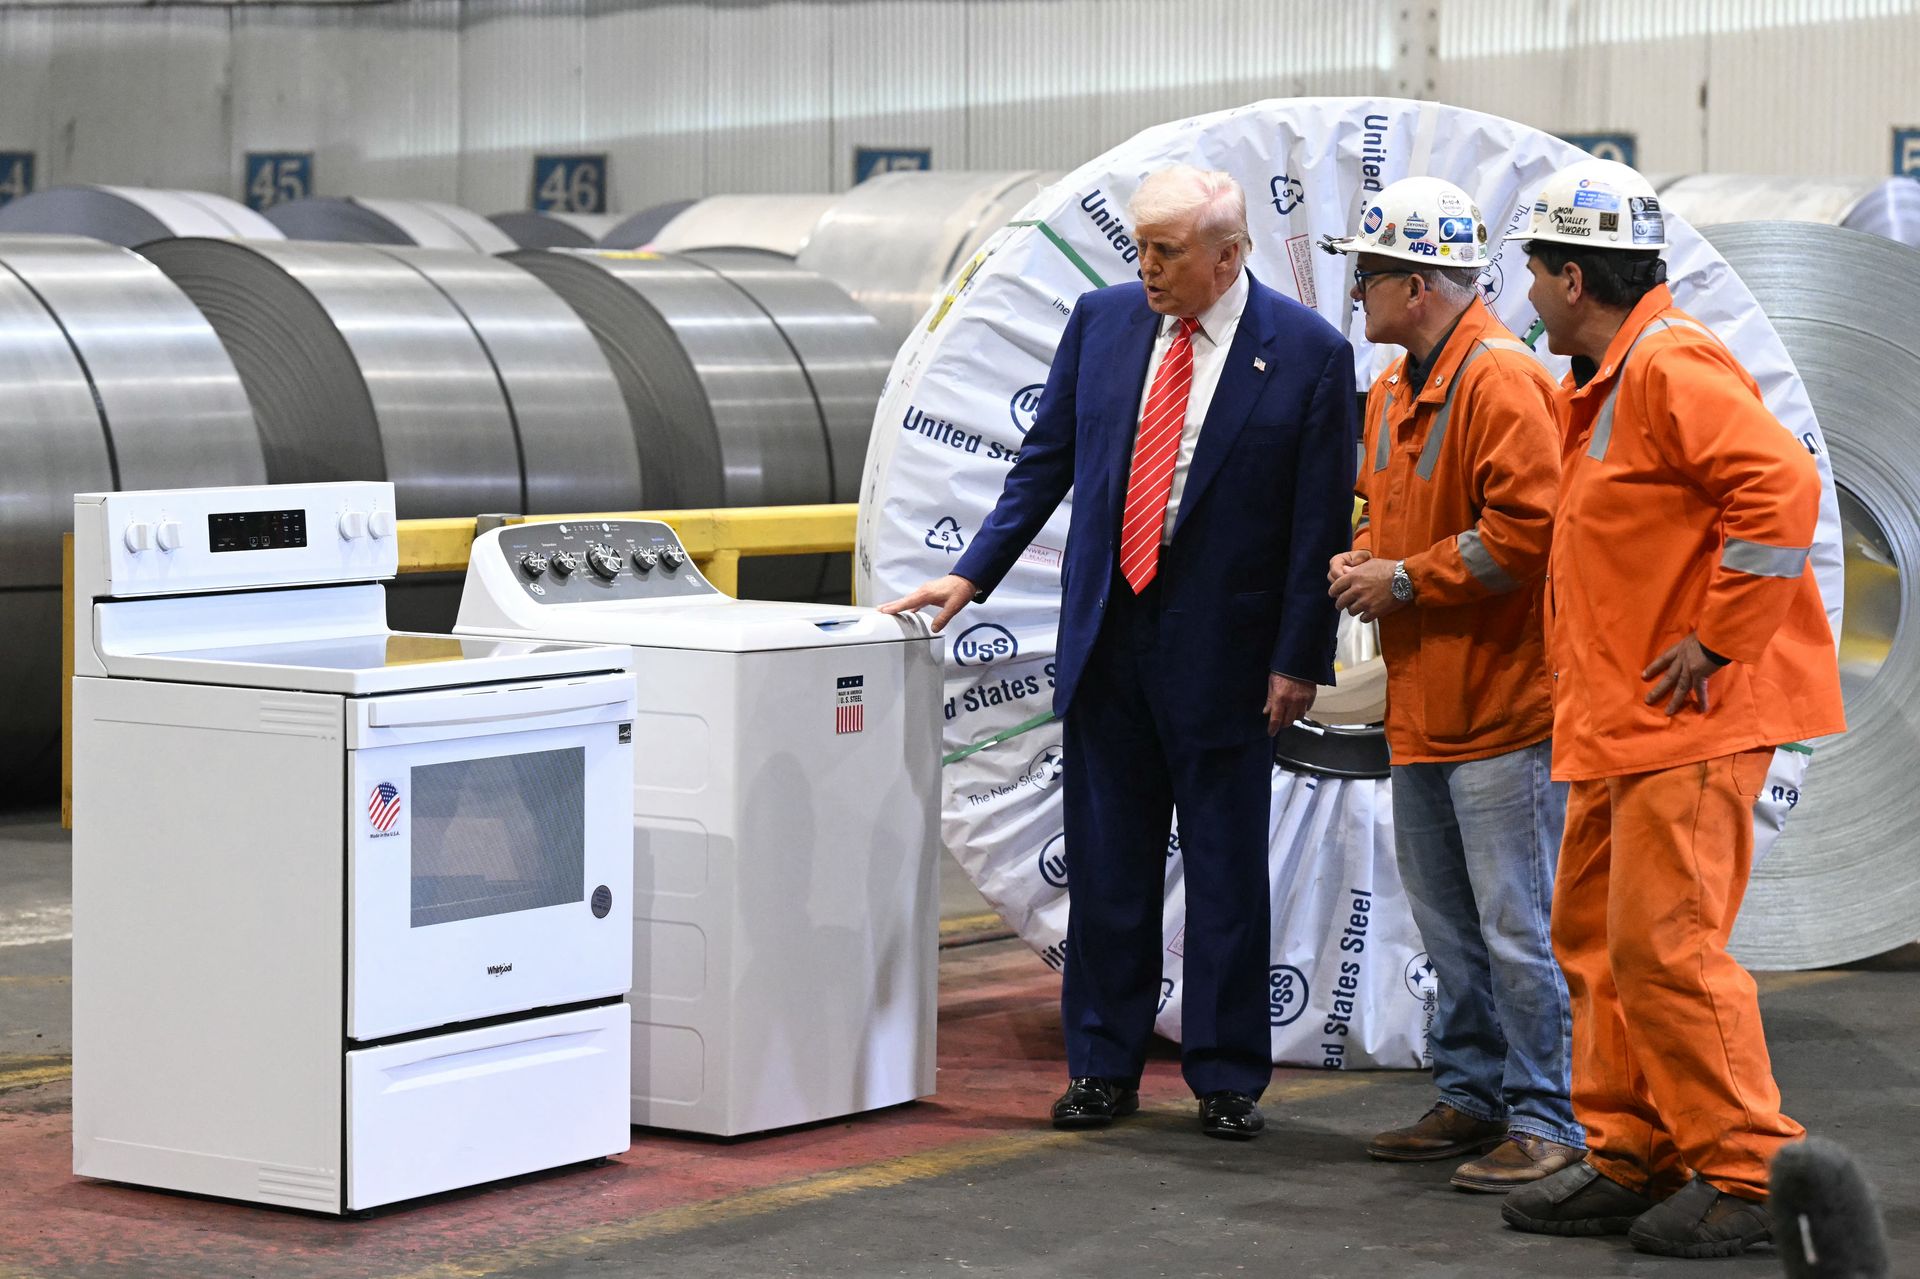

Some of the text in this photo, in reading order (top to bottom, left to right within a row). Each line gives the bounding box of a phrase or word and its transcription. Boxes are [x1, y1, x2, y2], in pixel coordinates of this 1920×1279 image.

[1361, 114, 1389, 192] United
[251, 159, 305, 206] 45
[541, 161, 599, 212] 46
[1512, 203, 1531, 223] The
[1558, 206, 1574, 215] MON
[1564, 216, 1588, 225] VALLEY
[1565, 225, 1591, 236] WORKS
[1408, 241, 1437, 256] APEX
[1303, 260, 1311, 275] STEEL
[1297, 265, 1312, 304] TEMPERATURE
[1051, 297, 1071, 316] The
[903, 405, 981, 454] United
[962, 636, 1010, 663] USS
[965, 675, 1040, 713] States
[967, 766, 1045, 807] The New Steel
[1340, 888, 1372, 954] Steel
[487, 962, 513, 977] Whirlpool
[1324, 961, 1361, 1037] States
[1422, 987, 1436, 1011] Steel
